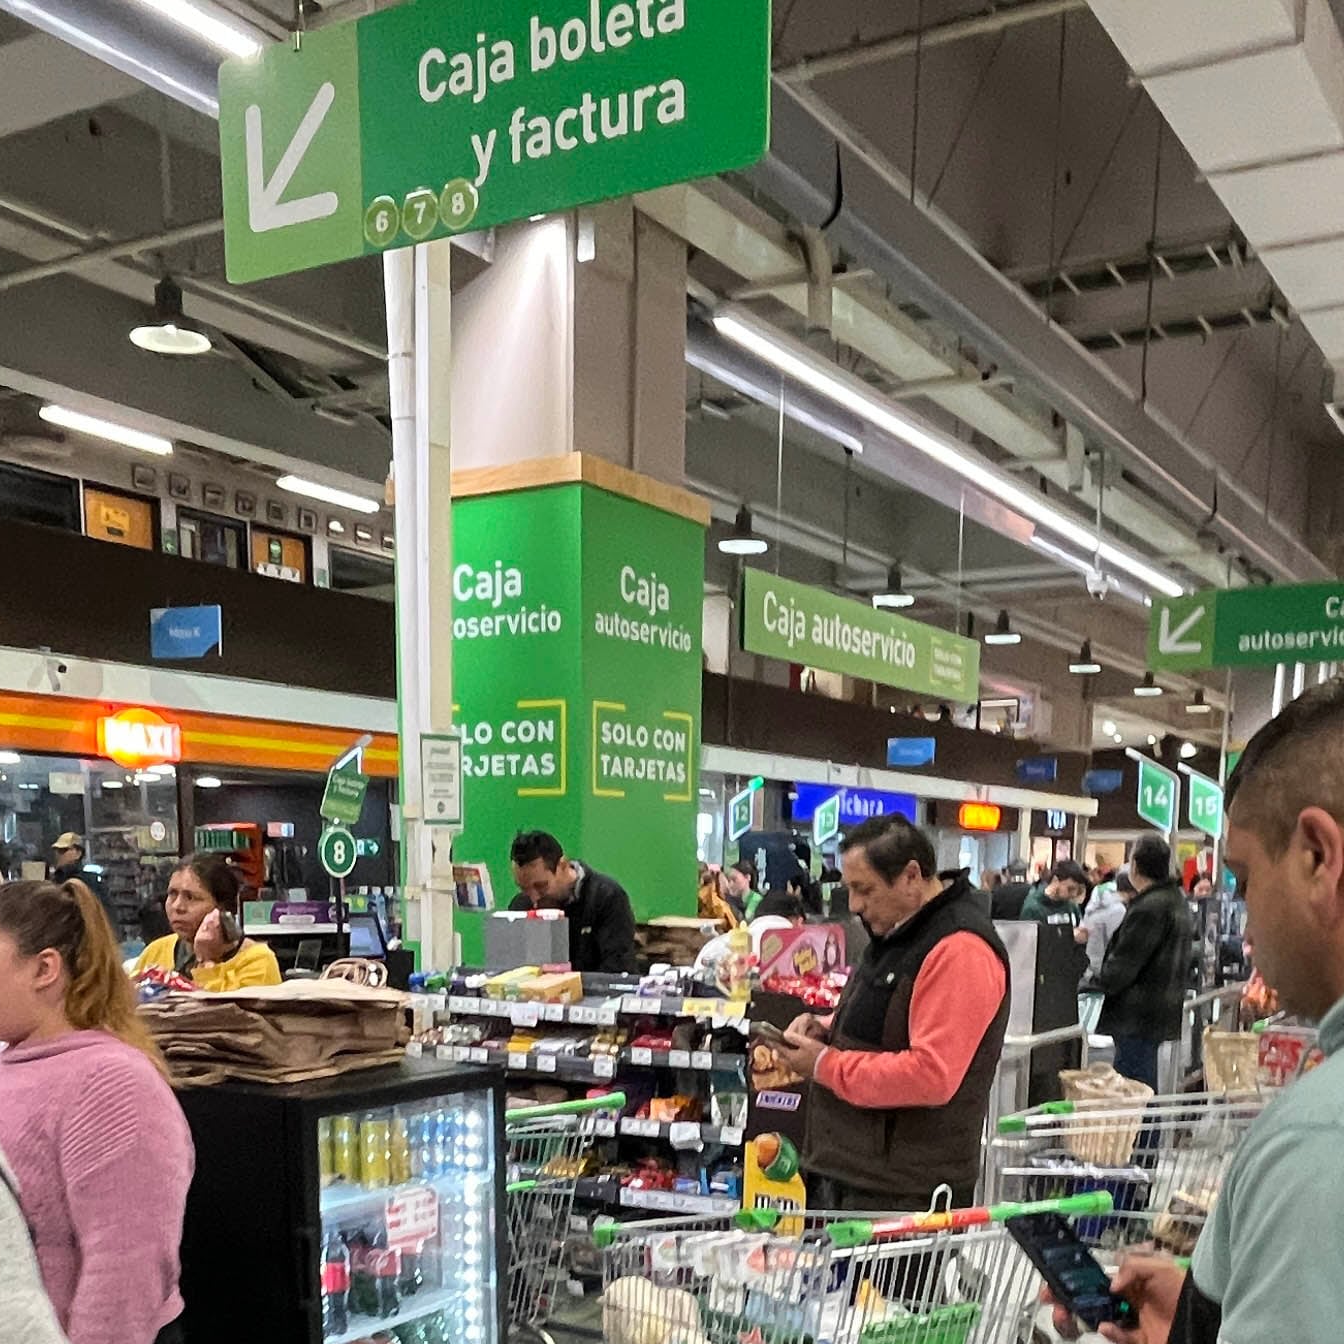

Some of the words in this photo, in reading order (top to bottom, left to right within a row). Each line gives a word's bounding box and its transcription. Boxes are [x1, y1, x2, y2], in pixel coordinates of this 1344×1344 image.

[418, 32, 514, 103] Caja
[529, 0, 686, 72] boleta
[471, 127, 497, 187] y
[509, 78, 686, 165] factura
[374, 209, 390, 233] 6
[413, 201, 427, 225] 7
[450, 190, 466, 214] 8
[453, 560, 523, 607] Caja
[620, 565, 670, 616] Caja
[452, 604, 561, 641] oservicio
[594, 611, 692, 653] autoservicio
[763, 590, 806, 648] Caja
[811, 613, 916, 669] autoservicio
[458, 720, 493, 745] LO
[501, 719, 555, 744] CON
[601, 720, 649, 748] SOLO
[652, 728, 686, 753] CON
[460, 752, 556, 777] RJETAS
[600, 753, 687, 784] TARJETAS
[1143, 784, 1169, 807] 14
[333, 839, 346, 865] 8
